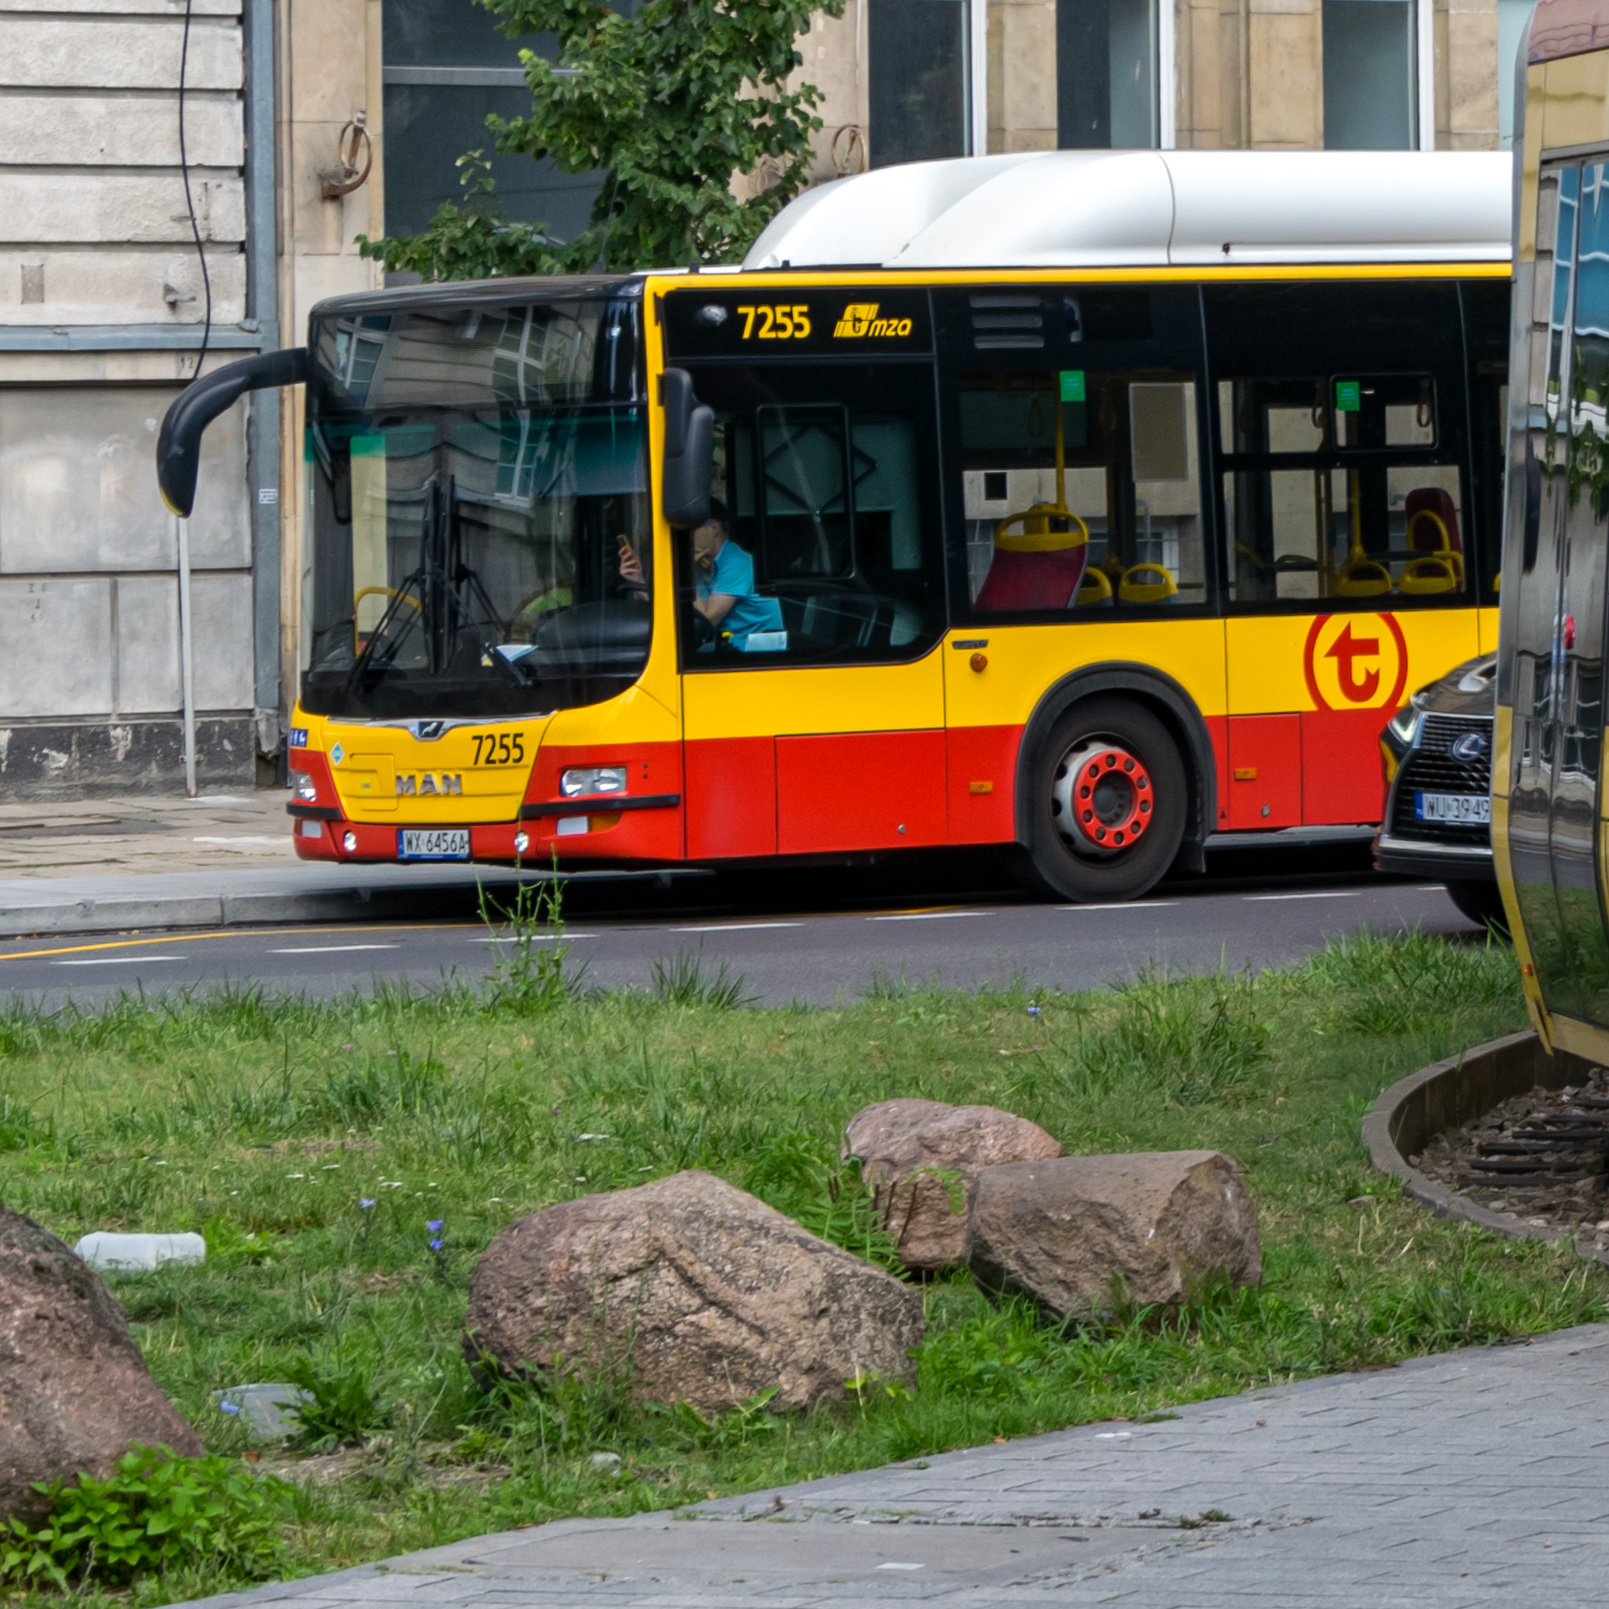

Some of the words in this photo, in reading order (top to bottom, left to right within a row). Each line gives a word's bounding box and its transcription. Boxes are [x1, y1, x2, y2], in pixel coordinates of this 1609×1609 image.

[737, 304, 811, 339] 7255
[472, 733, 524, 765] 7255
[396, 773, 462, 795] MAN
[405, 833, 421, 852] WX
[426, 833, 466, 852] 6456A
